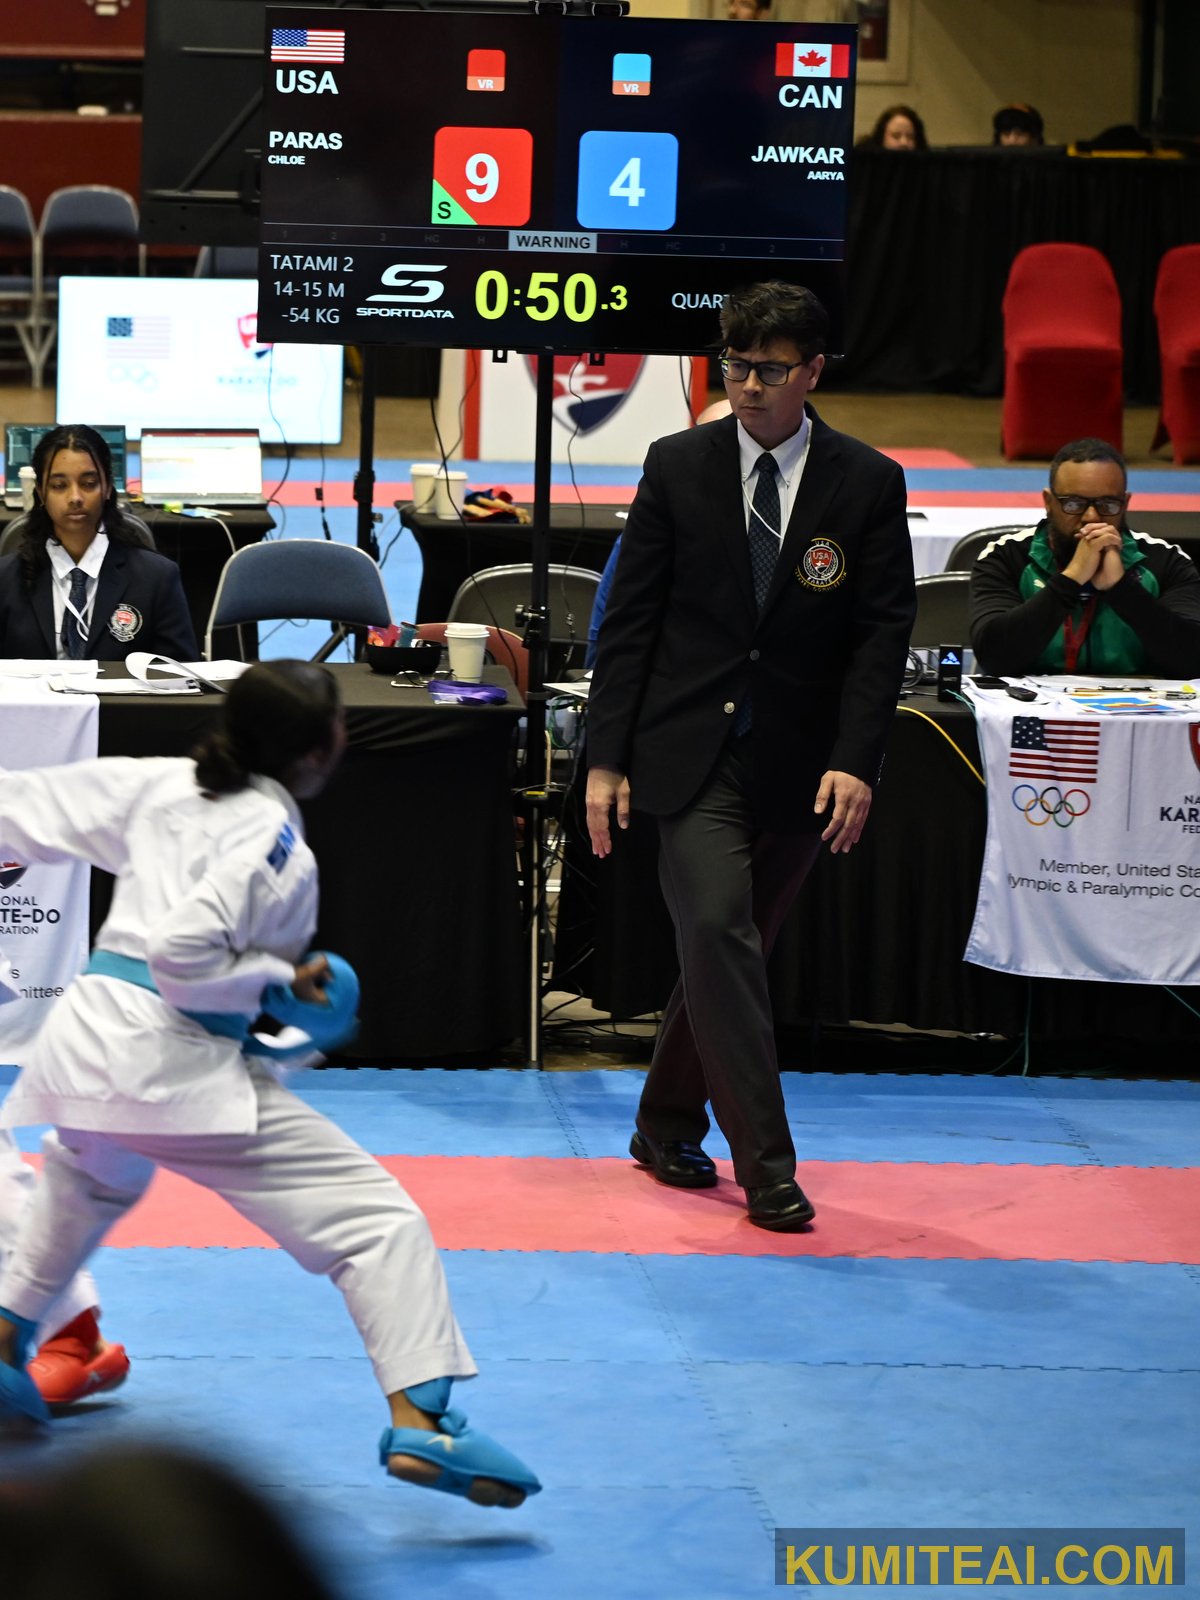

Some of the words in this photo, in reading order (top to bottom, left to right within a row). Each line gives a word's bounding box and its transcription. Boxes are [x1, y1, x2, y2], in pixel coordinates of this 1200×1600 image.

[275, 68, 340, 95] USA
[477, 78, 495, 89] VR
[622, 83, 640, 93] VR
[778, 83, 843, 109] CAN
[268, 130, 343, 150] PARAS
[267, 154, 306, 165] CHLOE
[751, 145, 845, 165] JAWKAR
[465, 153, 500, 203] 9
[608, 157, 646, 207] 4
[806, 170, 845, 181] AARYA
[436, 201, 452, 219] S
[330, 231, 337, 240] 2
[379, 232, 387, 241] 3
[516, 235, 591, 249] WARNING
[269, 254, 338, 271] TATAMI
[342, 256, 354, 272] 2
[273, 280, 322, 297] 14-15
[328, 282, 345, 298] M
[671, 292, 730, 310] QUAR
[281, 307, 310, 323] -54
[315, 308, 340, 324] KG
[355, 307, 455, 319] SPORTDATA
[812, 551, 830, 560] USA
[1039, 858, 1111, 877] Member,
[1116, 863, 1171, 878] United
[1008, 872, 1062, 893] lympic
[1066, 880, 1078, 894] &
[1081, 881, 1175, 899] Paralympic
